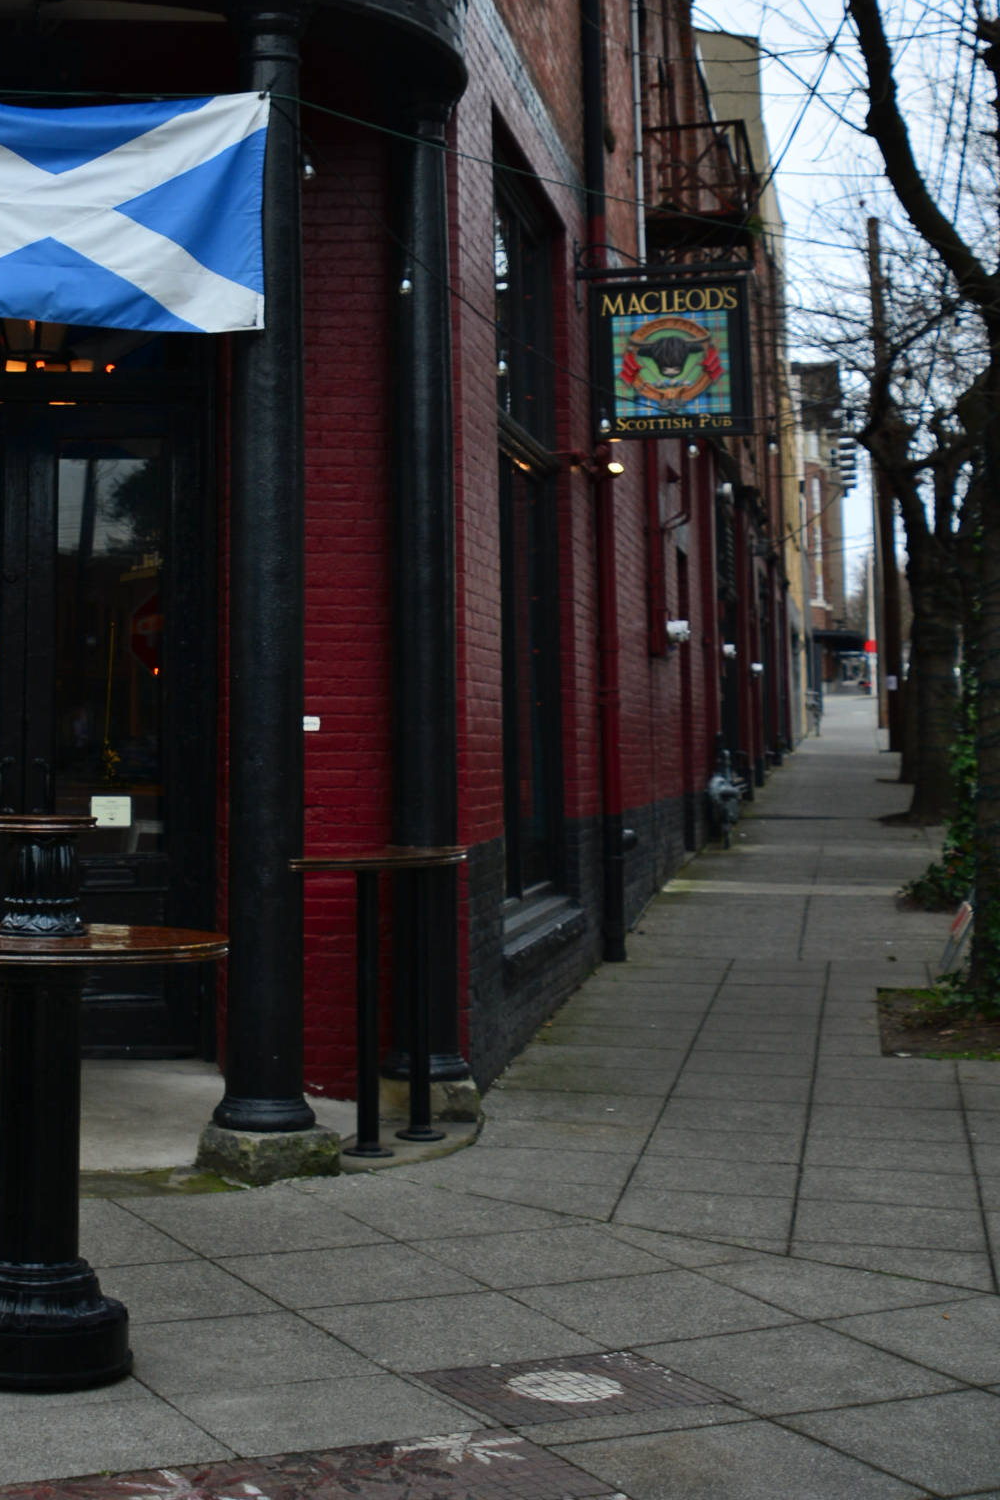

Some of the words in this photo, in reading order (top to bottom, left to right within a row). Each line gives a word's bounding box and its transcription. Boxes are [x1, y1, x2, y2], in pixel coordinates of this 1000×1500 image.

[601, 287, 738, 316] MACLEOD'S
[615, 417, 693, 431] SCOTTISH
[699, 413, 733, 428] PUB
